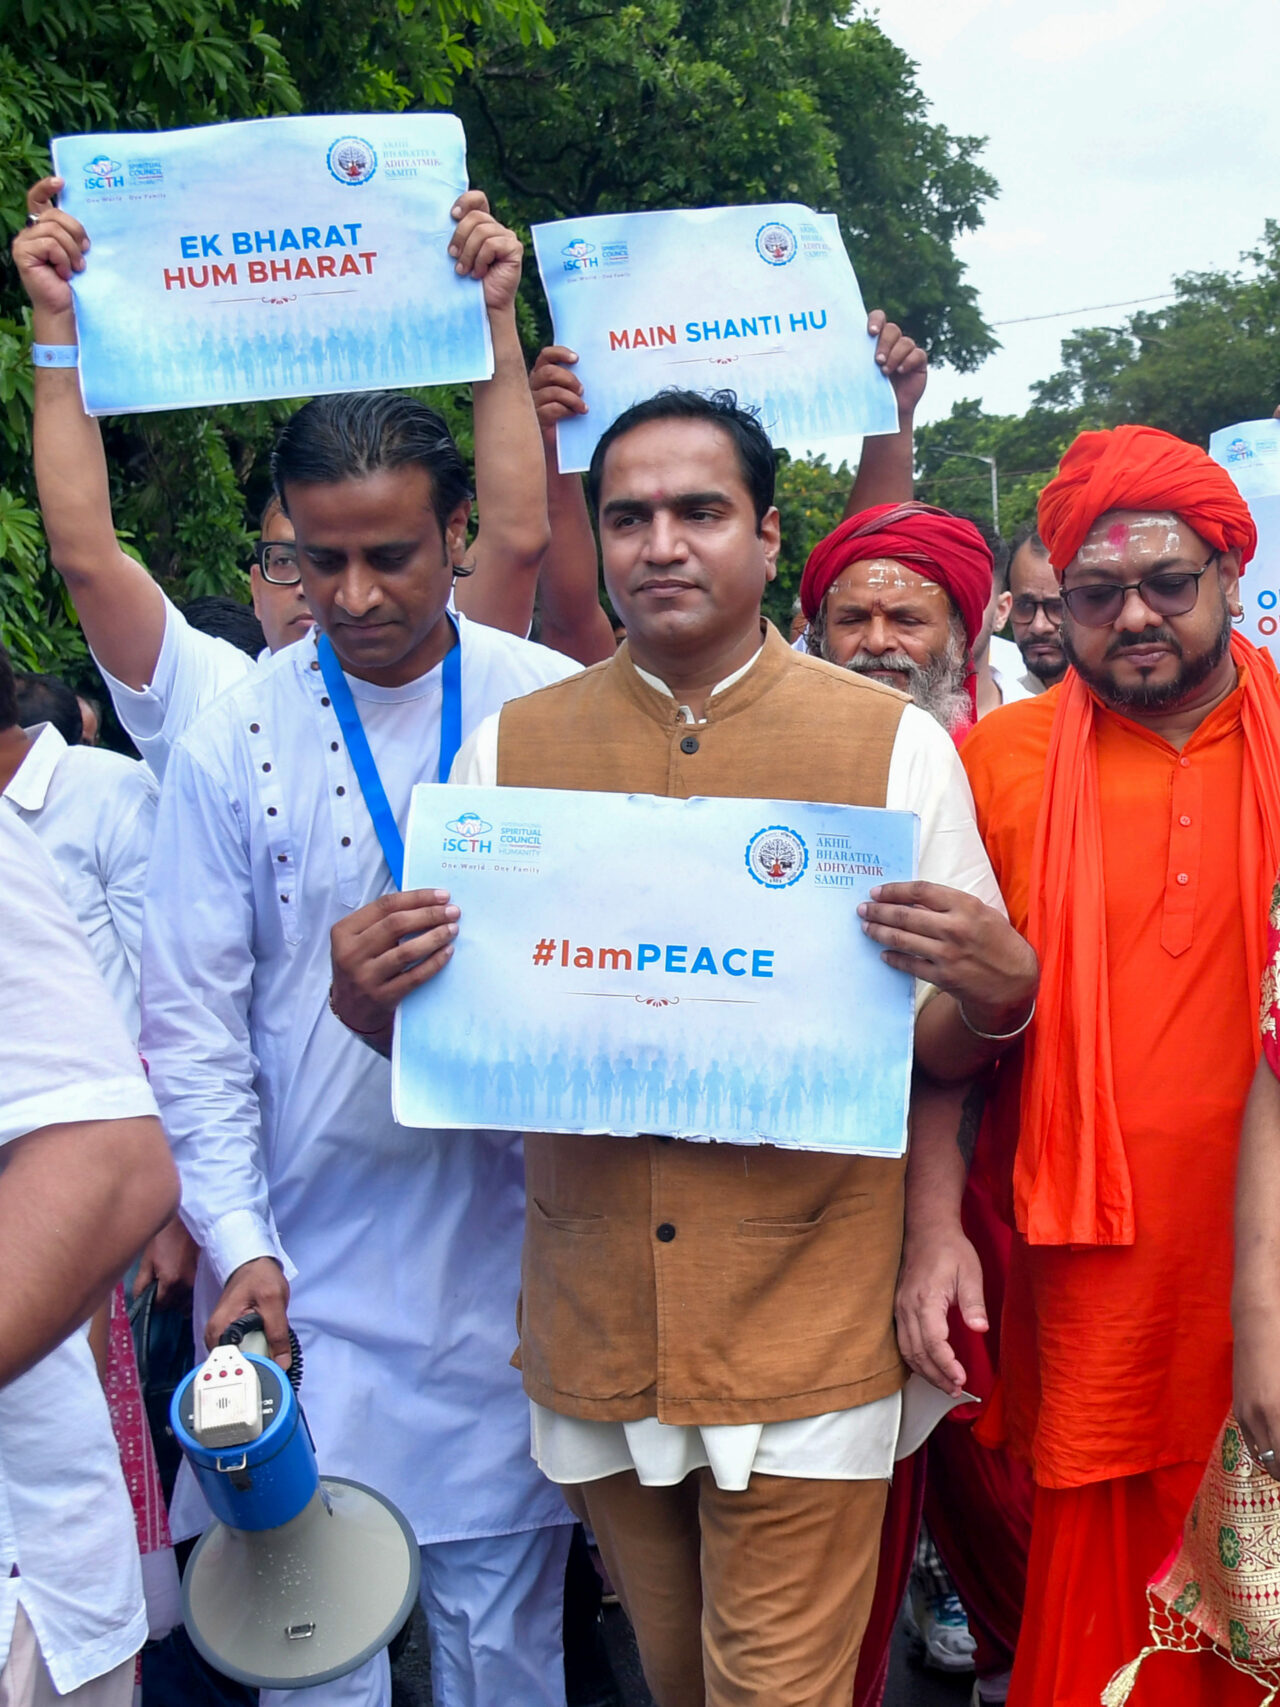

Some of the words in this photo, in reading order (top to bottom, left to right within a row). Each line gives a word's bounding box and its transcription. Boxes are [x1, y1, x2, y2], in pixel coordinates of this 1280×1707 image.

[84, 175, 125, 190] iSCTH
[180, 234, 223, 259] EK
[232, 223, 362, 255] BHARAT
[163, 263, 238, 291] HUM
[248, 252, 377, 284] BHARAT
[608, 324, 677, 351] MAIN
[685, 314, 782, 343] SHANTI
[789, 309, 828, 333] HU
[500, 827, 542, 836] SPIRITUAL
[443, 838, 492, 853] iSCTH
[500, 835, 542, 845] COUNCIL
[816, 837, 852, 849] AKHIL
[816, 849, 881, 864] BHARATIYA
[460, 863, 486, 871] World
[513, 866, 540, 874] Family
[815, 862, 884, 877] ADHYATMIK
[814, 874, 855, 887] SAMITI
[532, 938, 775, 978] #IamPEACE
